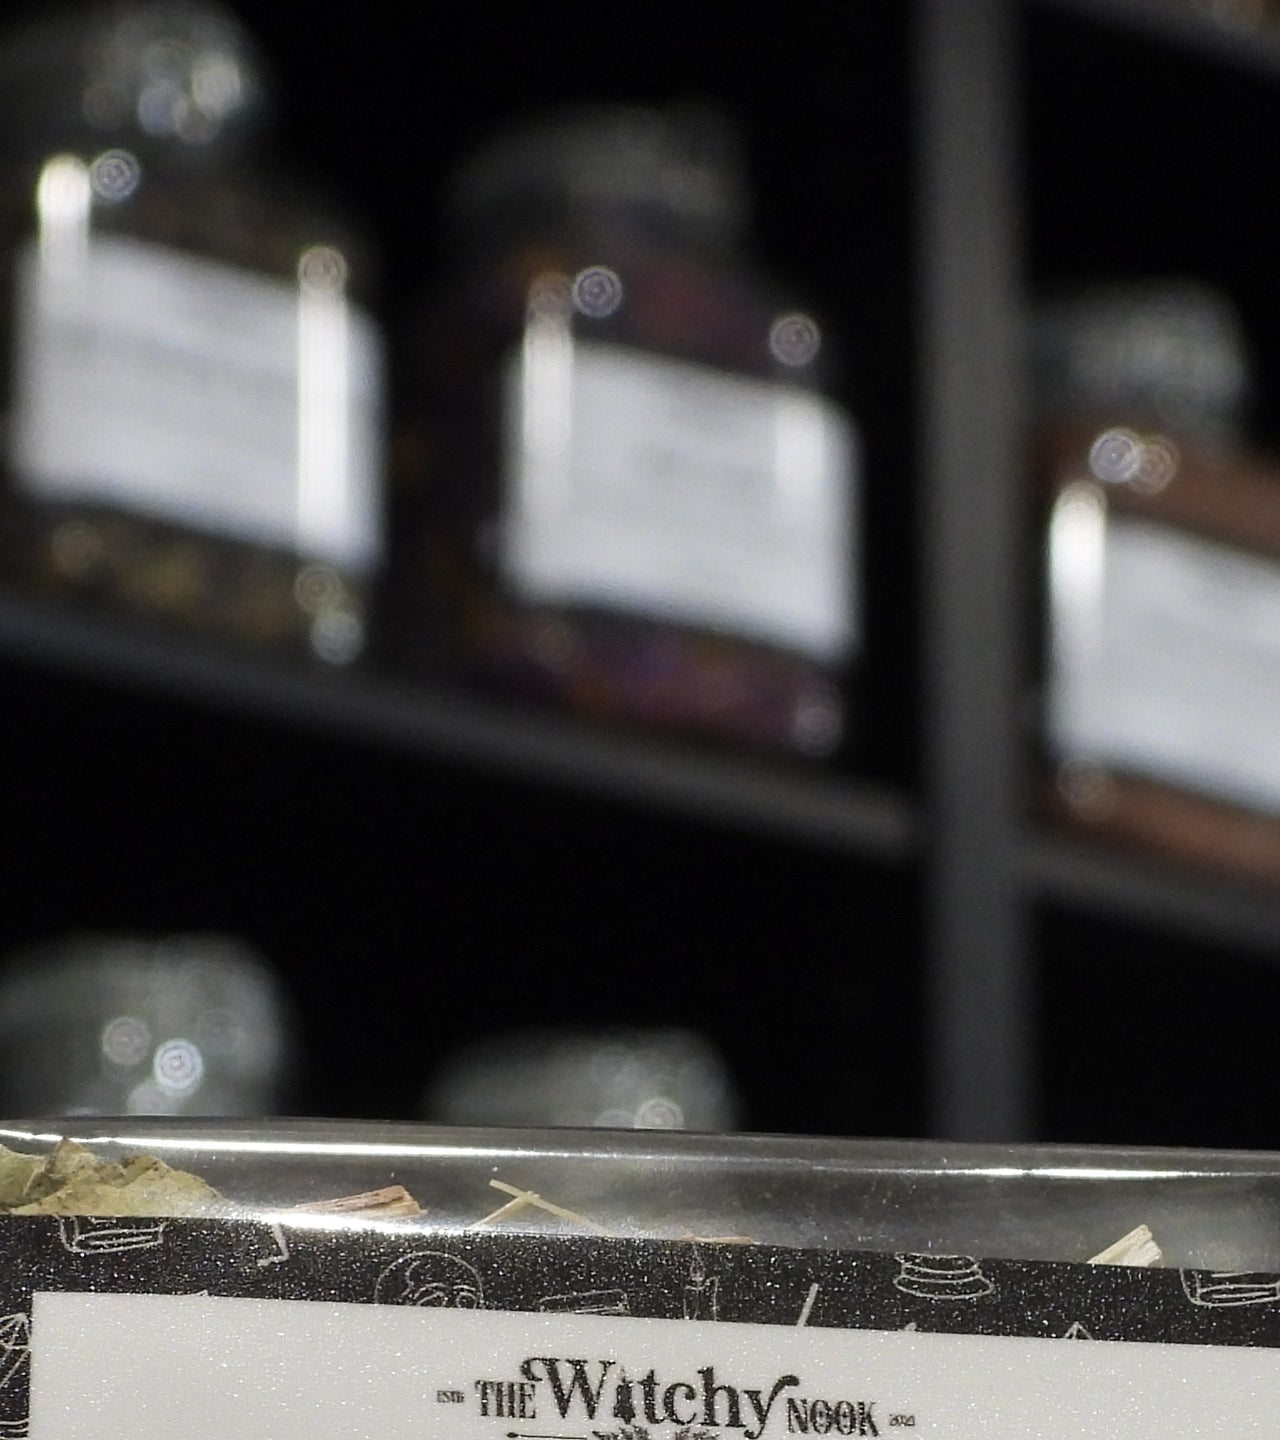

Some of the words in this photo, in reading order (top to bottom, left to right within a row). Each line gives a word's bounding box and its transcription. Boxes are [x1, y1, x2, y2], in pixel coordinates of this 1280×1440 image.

[474, 1379, 537, 1419] THE
[519, 1356, 801, 1440] Witchy
[786, 1397, 880, 1438] NOOK
